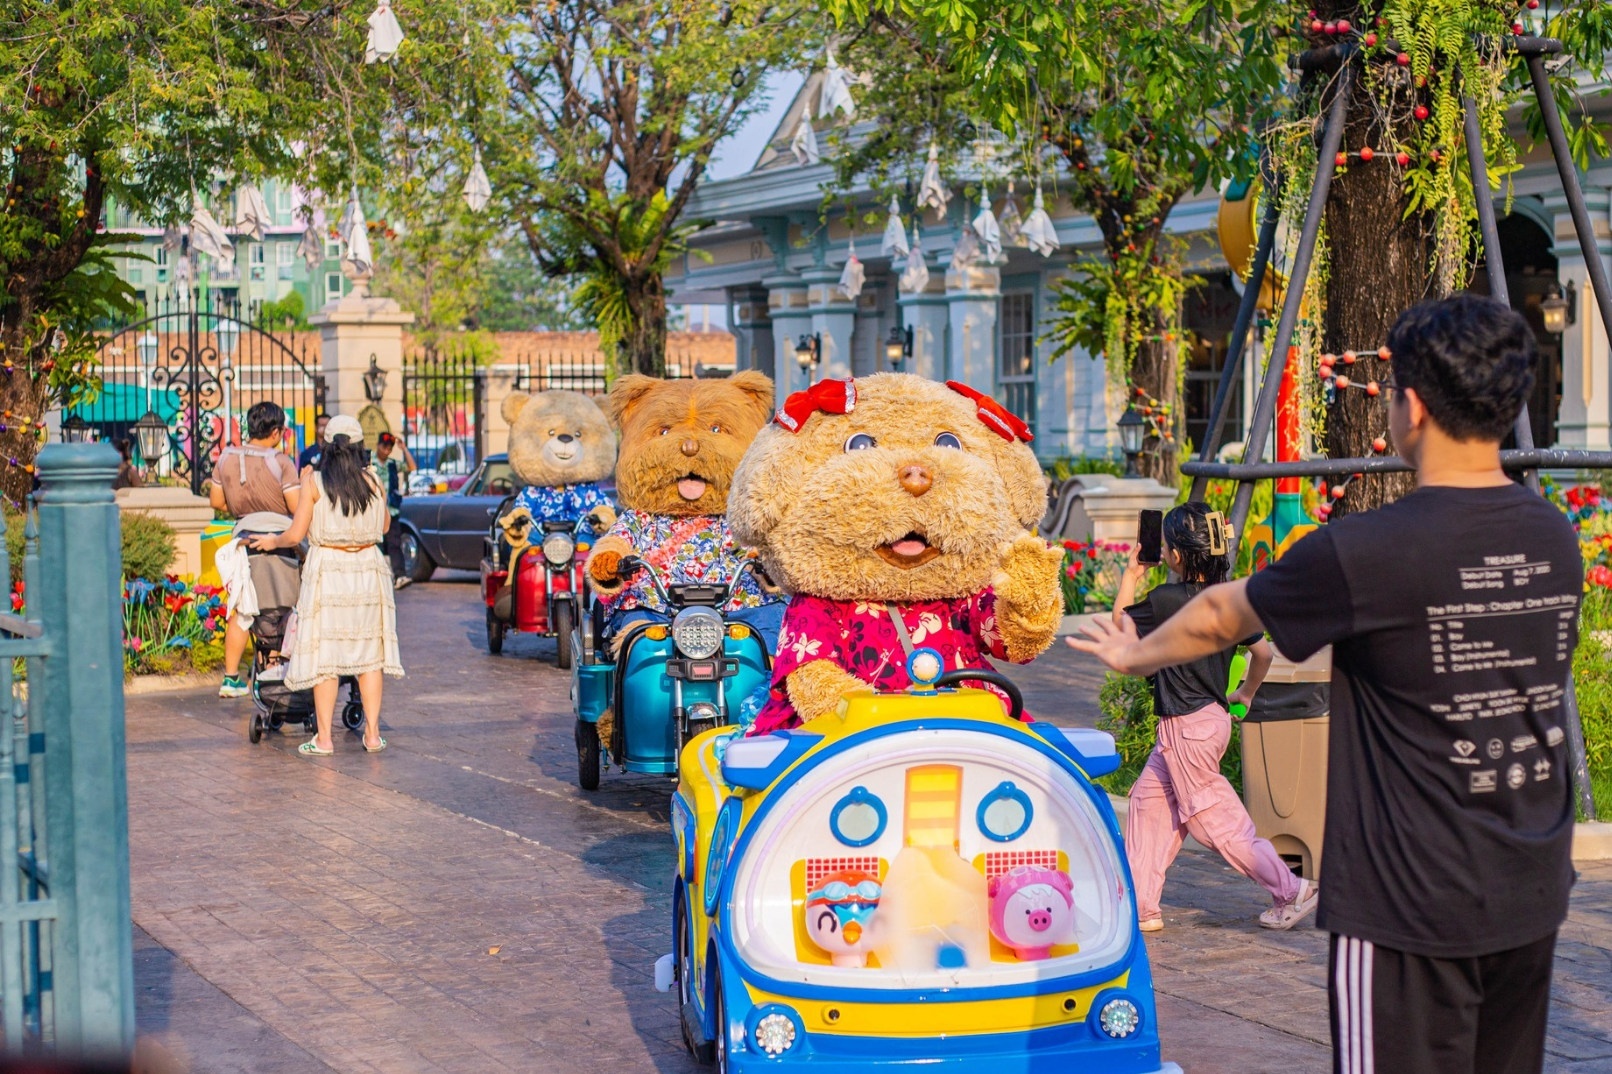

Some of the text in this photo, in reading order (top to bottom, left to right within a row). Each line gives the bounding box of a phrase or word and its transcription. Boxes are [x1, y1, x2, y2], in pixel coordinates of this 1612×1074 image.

[1484, 553, 1526, 565] TREASURE
[1427, 605, 1445, 616] The
[1445, 604, 1464, 613] First
[1464, 602, 1486, 613] Step
[1490, 600, 1524, 611] Chapter
[1525, 598, 1542, 608] One
